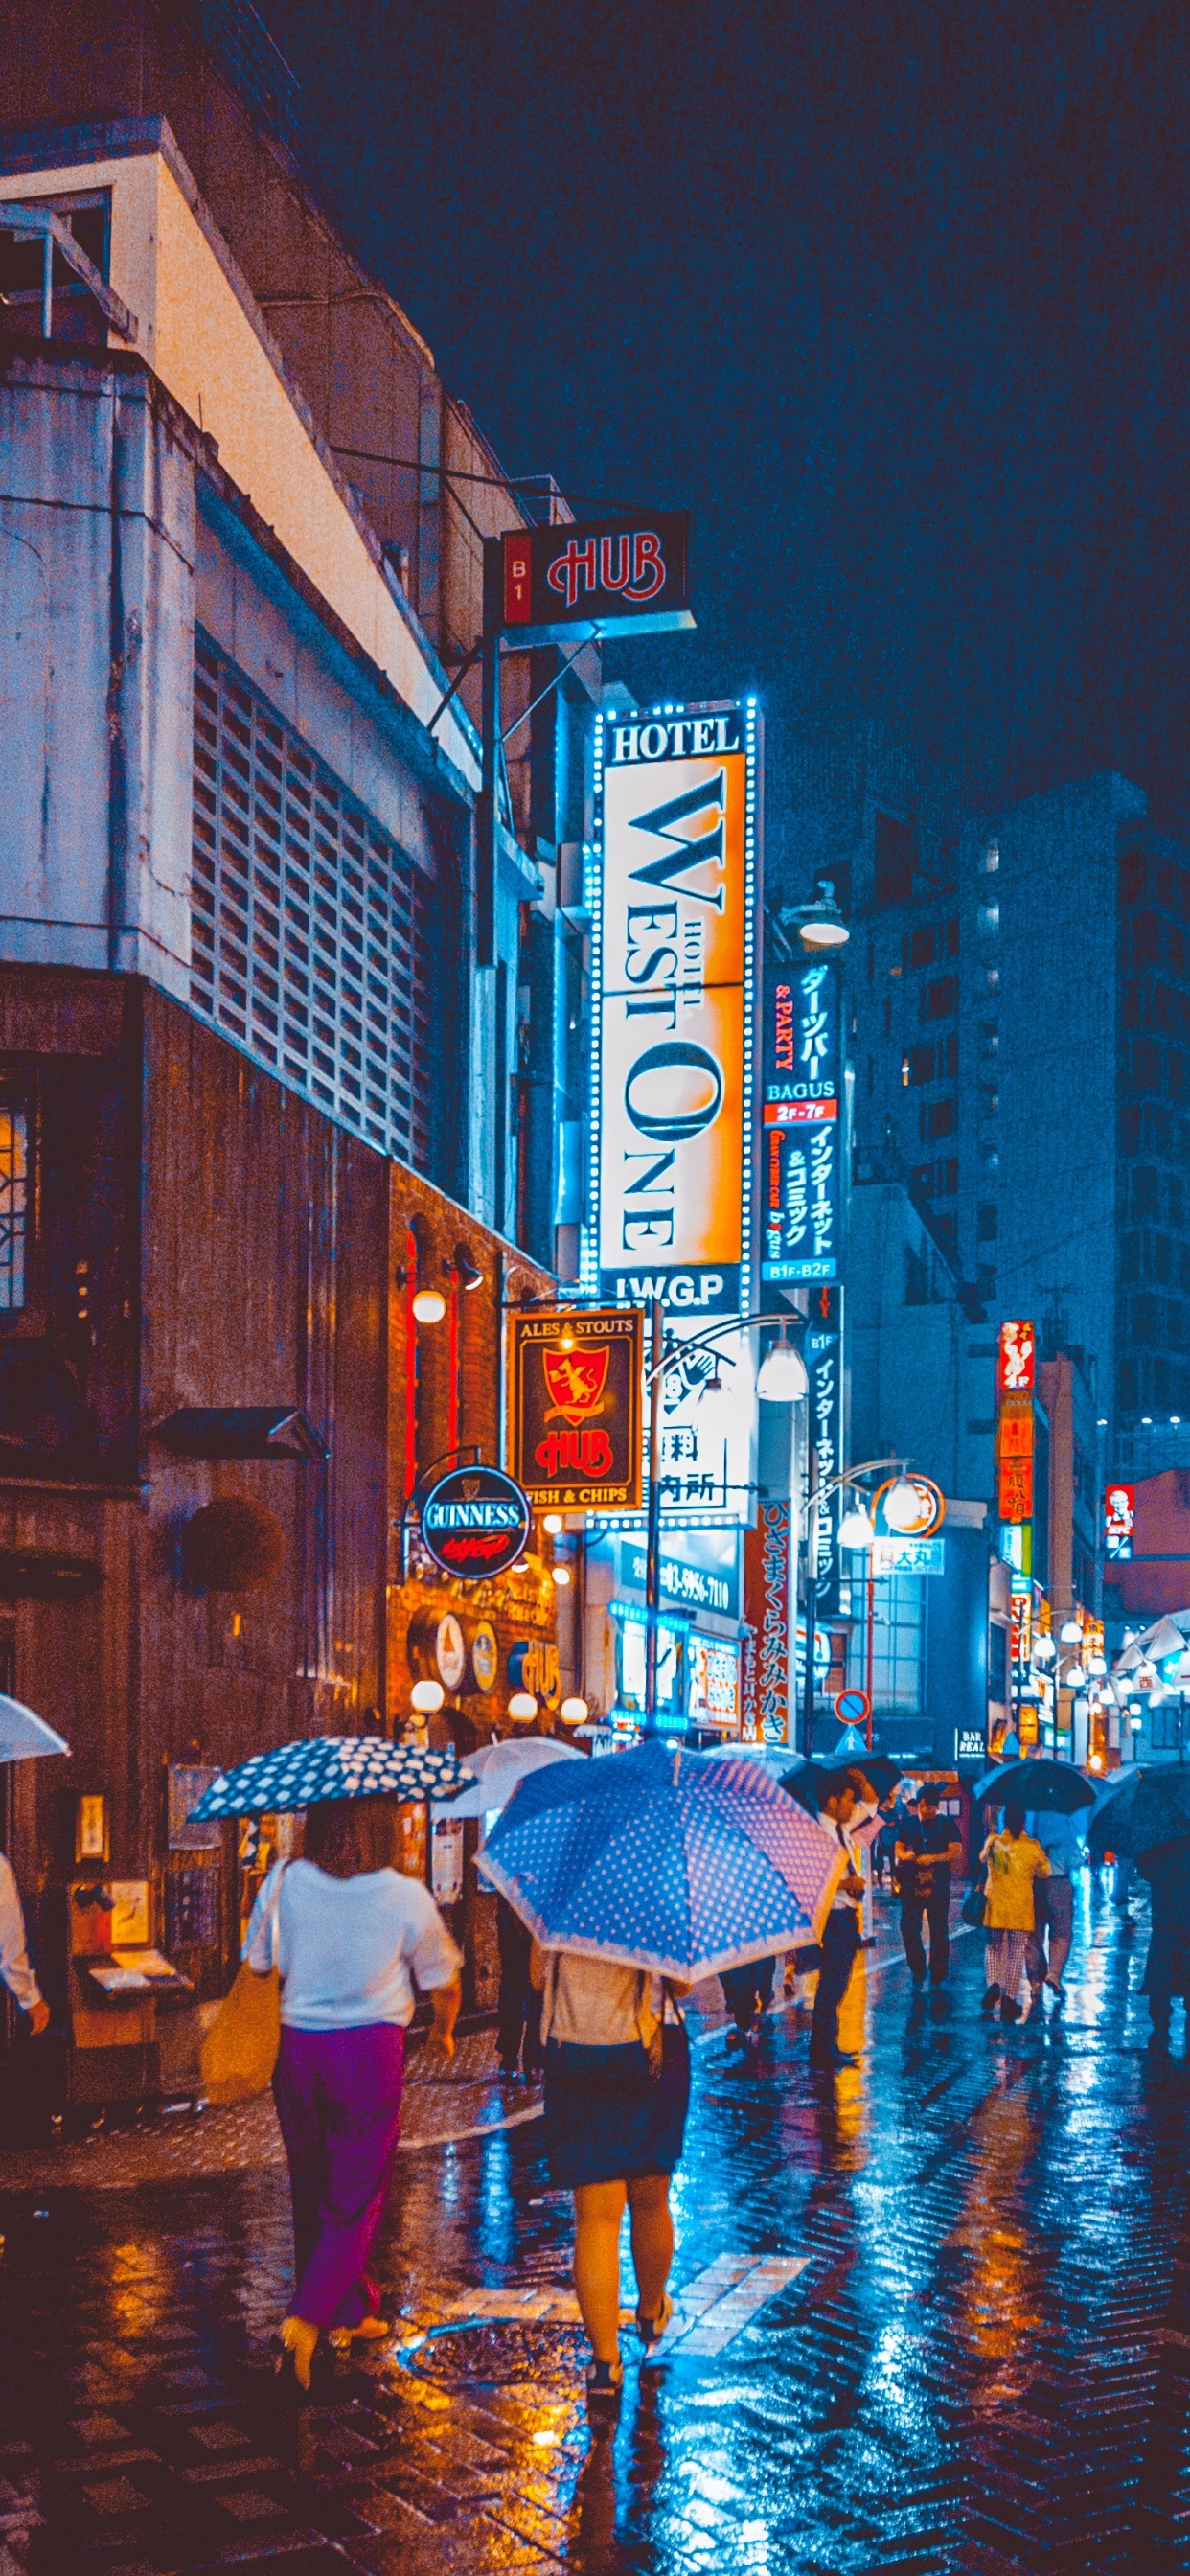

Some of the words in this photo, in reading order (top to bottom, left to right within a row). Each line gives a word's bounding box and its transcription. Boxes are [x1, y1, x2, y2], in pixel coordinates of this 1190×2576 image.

[547, 532, 666, 608] HUB
[611, 718, 739, 761] HOTEL
[625, 767, 726, 1030] WEST
[683, 920, 702, 1006] HOTEL
[775, 984, 790, 1000] &
[775, 1000, 793, 1071] PARTY
[800, 965, 828, 1080] ダーツバー
[767, 1080, 835, 1101] BAGUS
[777, 1104, 825, 1122] 2F-7F
[623, 1041, 723, 1251] ONE
[811, 1125, 833, 1256] インターネット
[769, 1263, 831, 1279] B1F-B2F
[520, 1322, 560, 1338] ALES
[561, 1322, 574, 1335] &
[576, 1319, 634, 1335] STOUTS
[812, 1334, 832, 1349] B1F
[535, 1429, 613, 1478] HUB
[563, 1489, 576, 1504] &
[579, 1487, 628, 1503] CHIPS
[427, 1502, 520, 1529] GUINNESS
[959, 1741, 985, 1752] REAL
[963, 1731, 981, 1741] BAR
